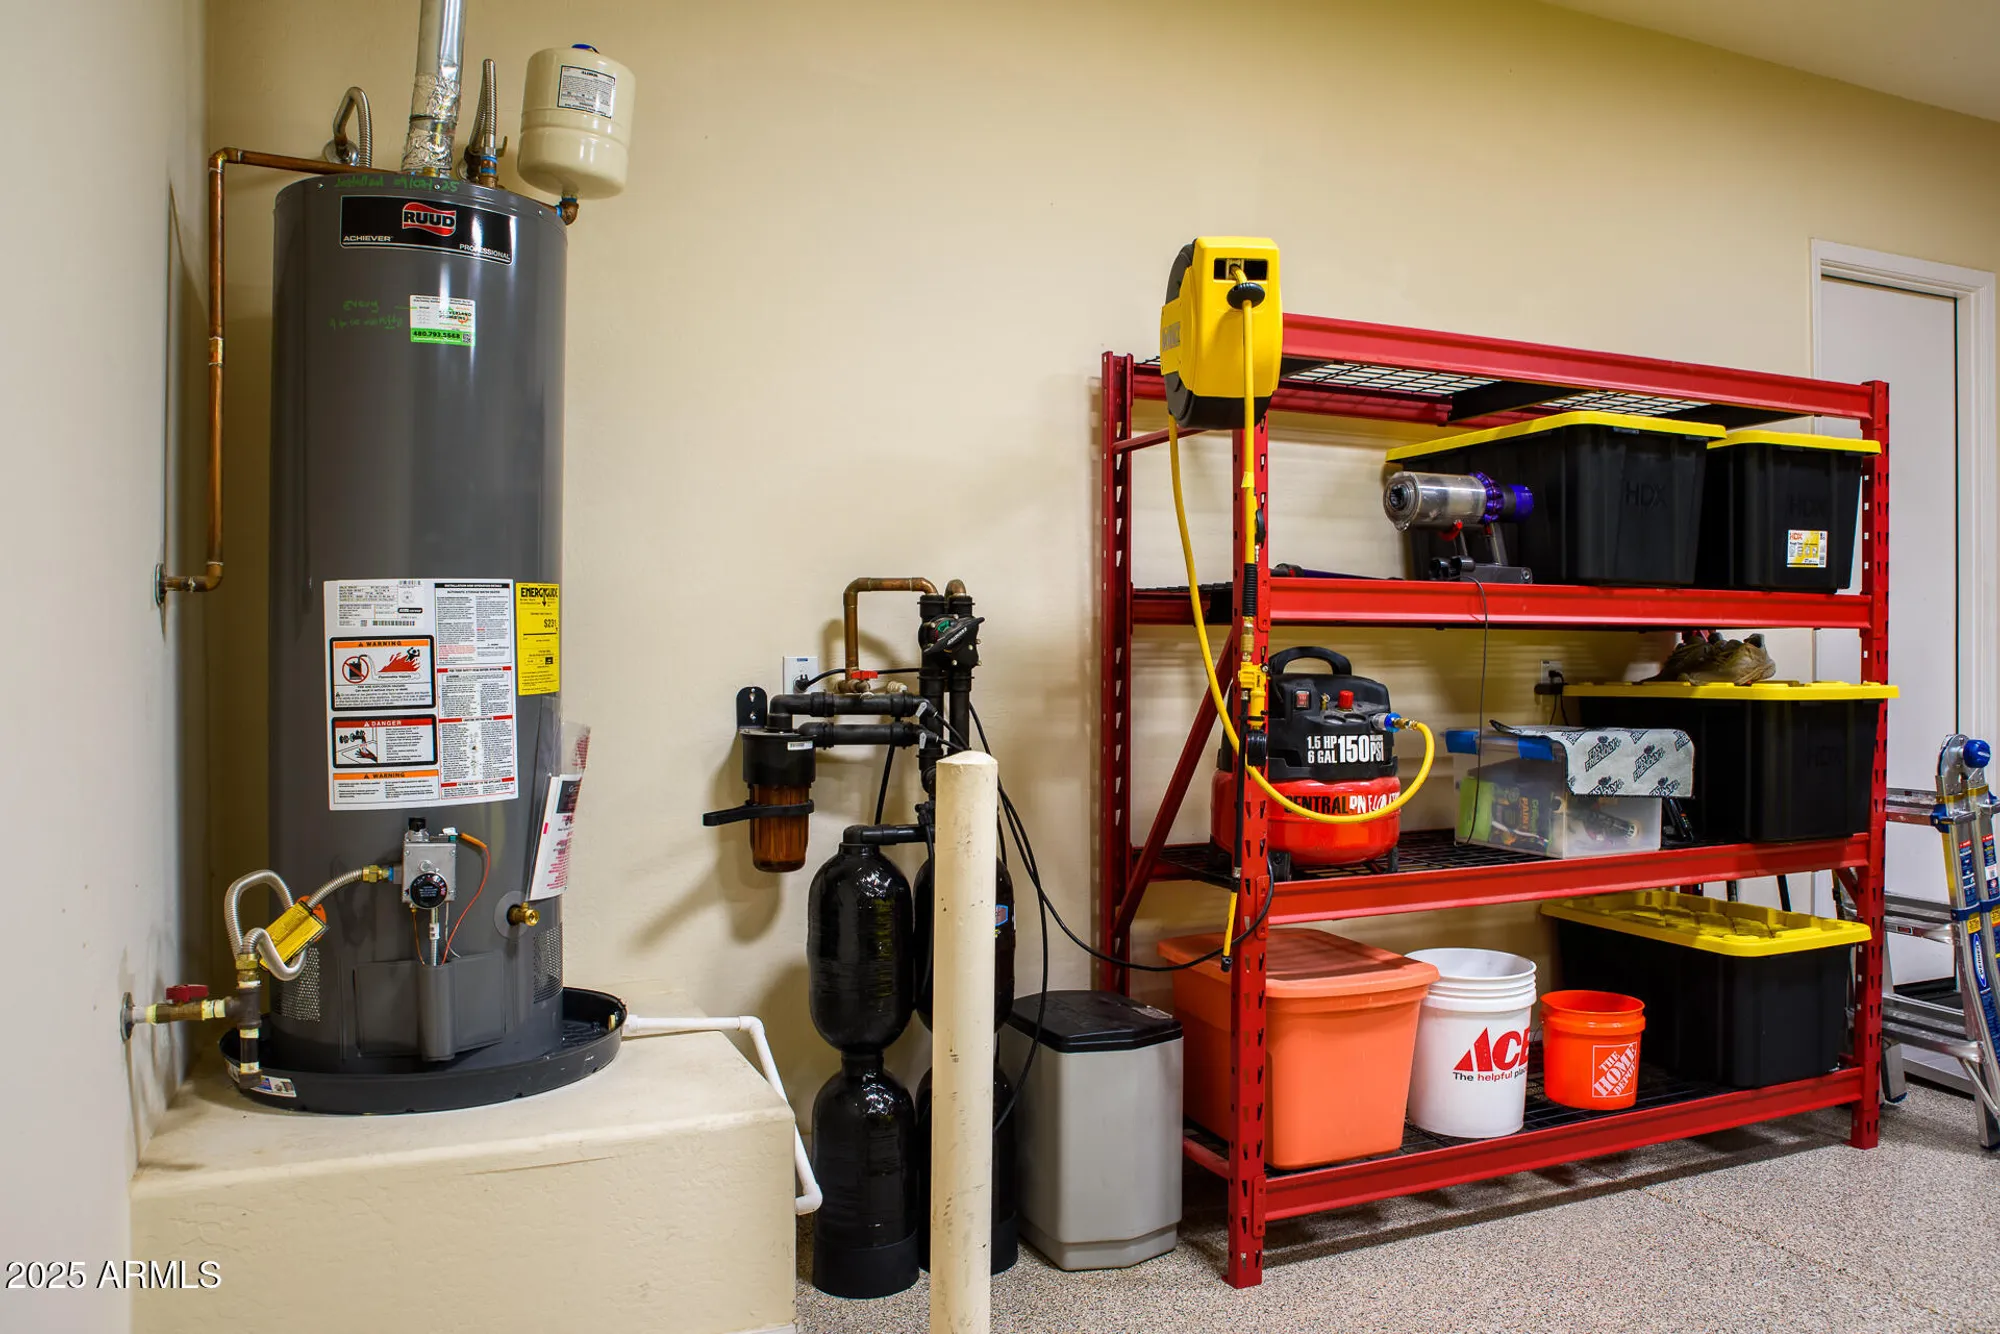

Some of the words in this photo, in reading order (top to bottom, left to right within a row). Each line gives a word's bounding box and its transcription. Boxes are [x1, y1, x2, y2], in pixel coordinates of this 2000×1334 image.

[403, 210, 456, 228] RUUD
[459, 243, 511, 261] PROSSIONAL
[1625, 481, 1669, 509] HDX
[1307, 736, 1321, 749] 1.5
[1323, 735, 1337, 749] HP
[1338, 734, 1370, 763] 150
[1370, 741, 1384, 762] PSI
[1307, 750, 1315, 764] 6
[1317, 749, 1338, 763] GAL
[1594, 1044, 1636, 1096] HOME
[1598, 1051, 1620, 1072] THE
[1452, 1071, 1474, 1081] The
[1477, 1071, 1513, 1082] helpful
